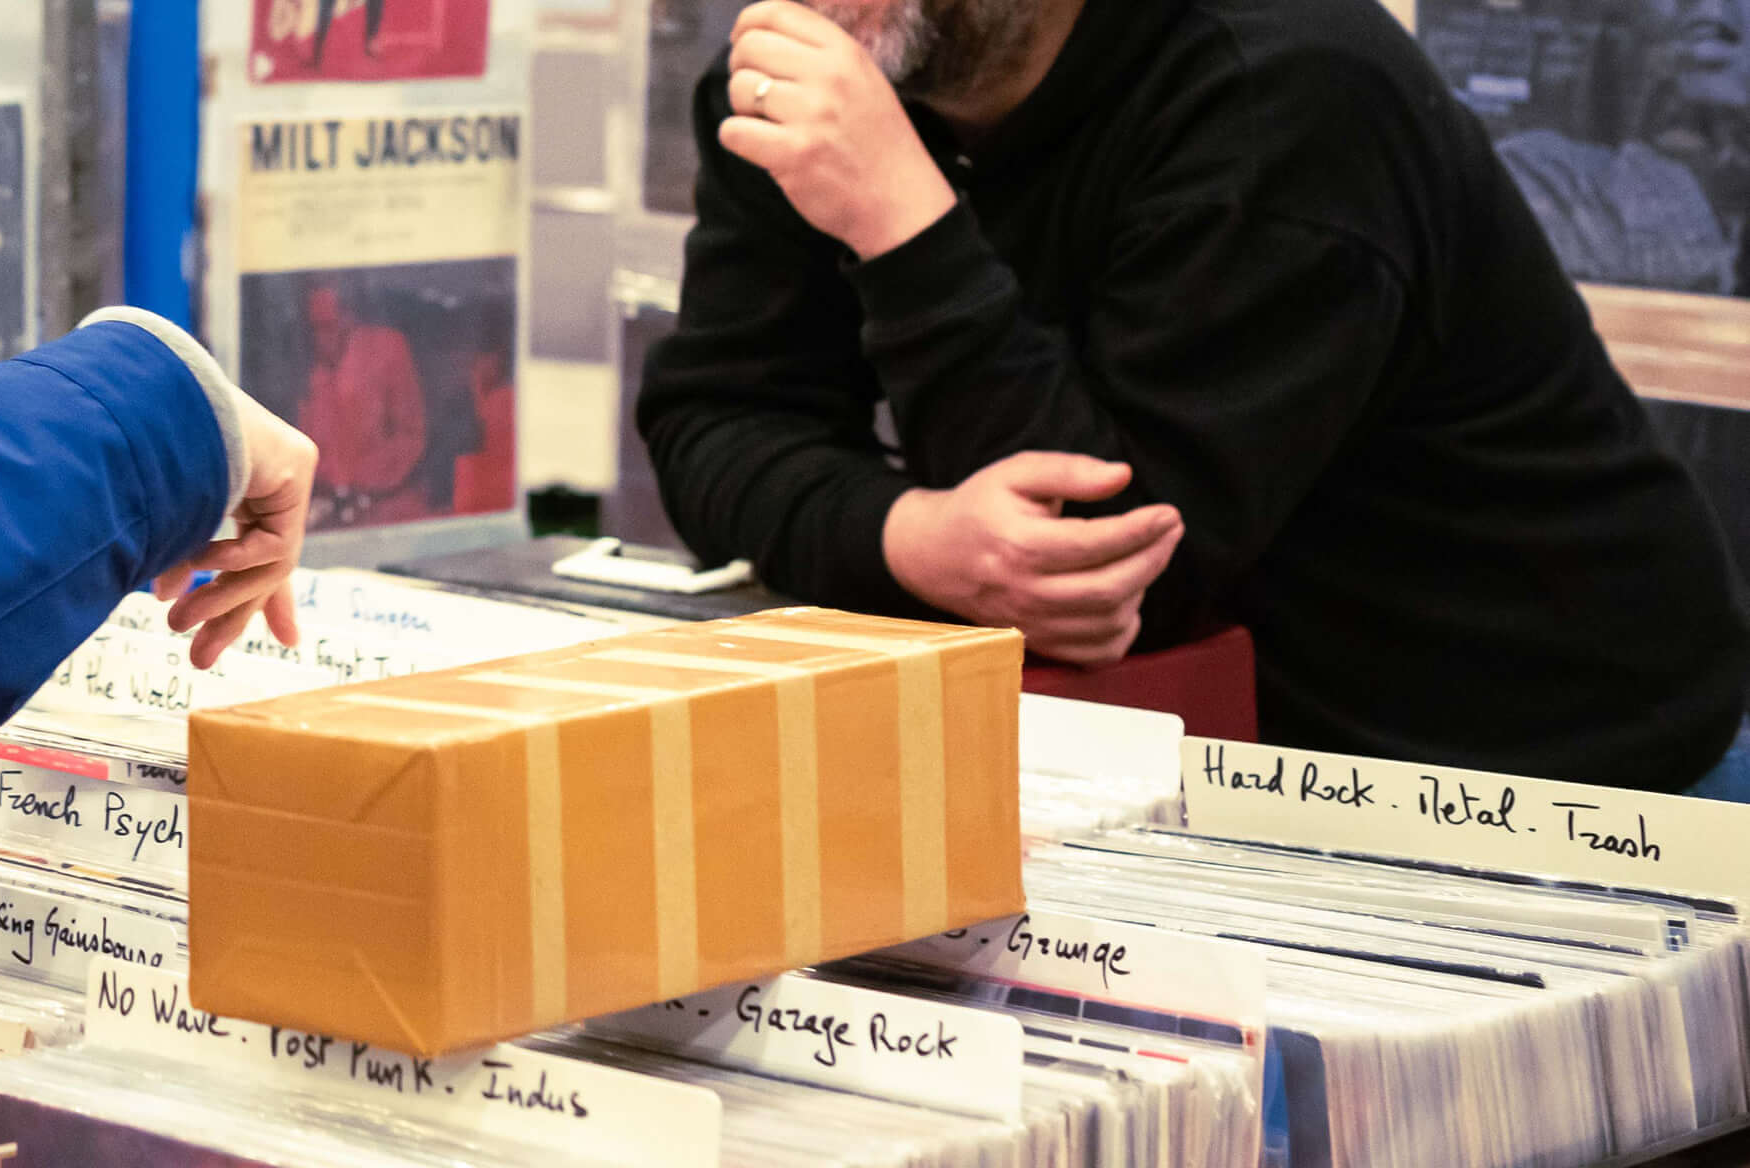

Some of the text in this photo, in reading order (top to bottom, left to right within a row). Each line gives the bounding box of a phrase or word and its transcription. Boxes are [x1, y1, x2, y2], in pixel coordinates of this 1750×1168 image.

[250, 115, 520, 172] MILT JACKSON
[104, 791, 184, 861] Psych
[1203, 744, 1286, 797] Hard
[1552, 801, 1661, 862] Trash
[1007, 913, 1131, 992] Grunge
[98, 970, 135, 1017] No
[481, 1058, 589, 1118] Indus
[736, 985, 858, 1068] Garage
[869, 1012, 959, 1059] Rock
